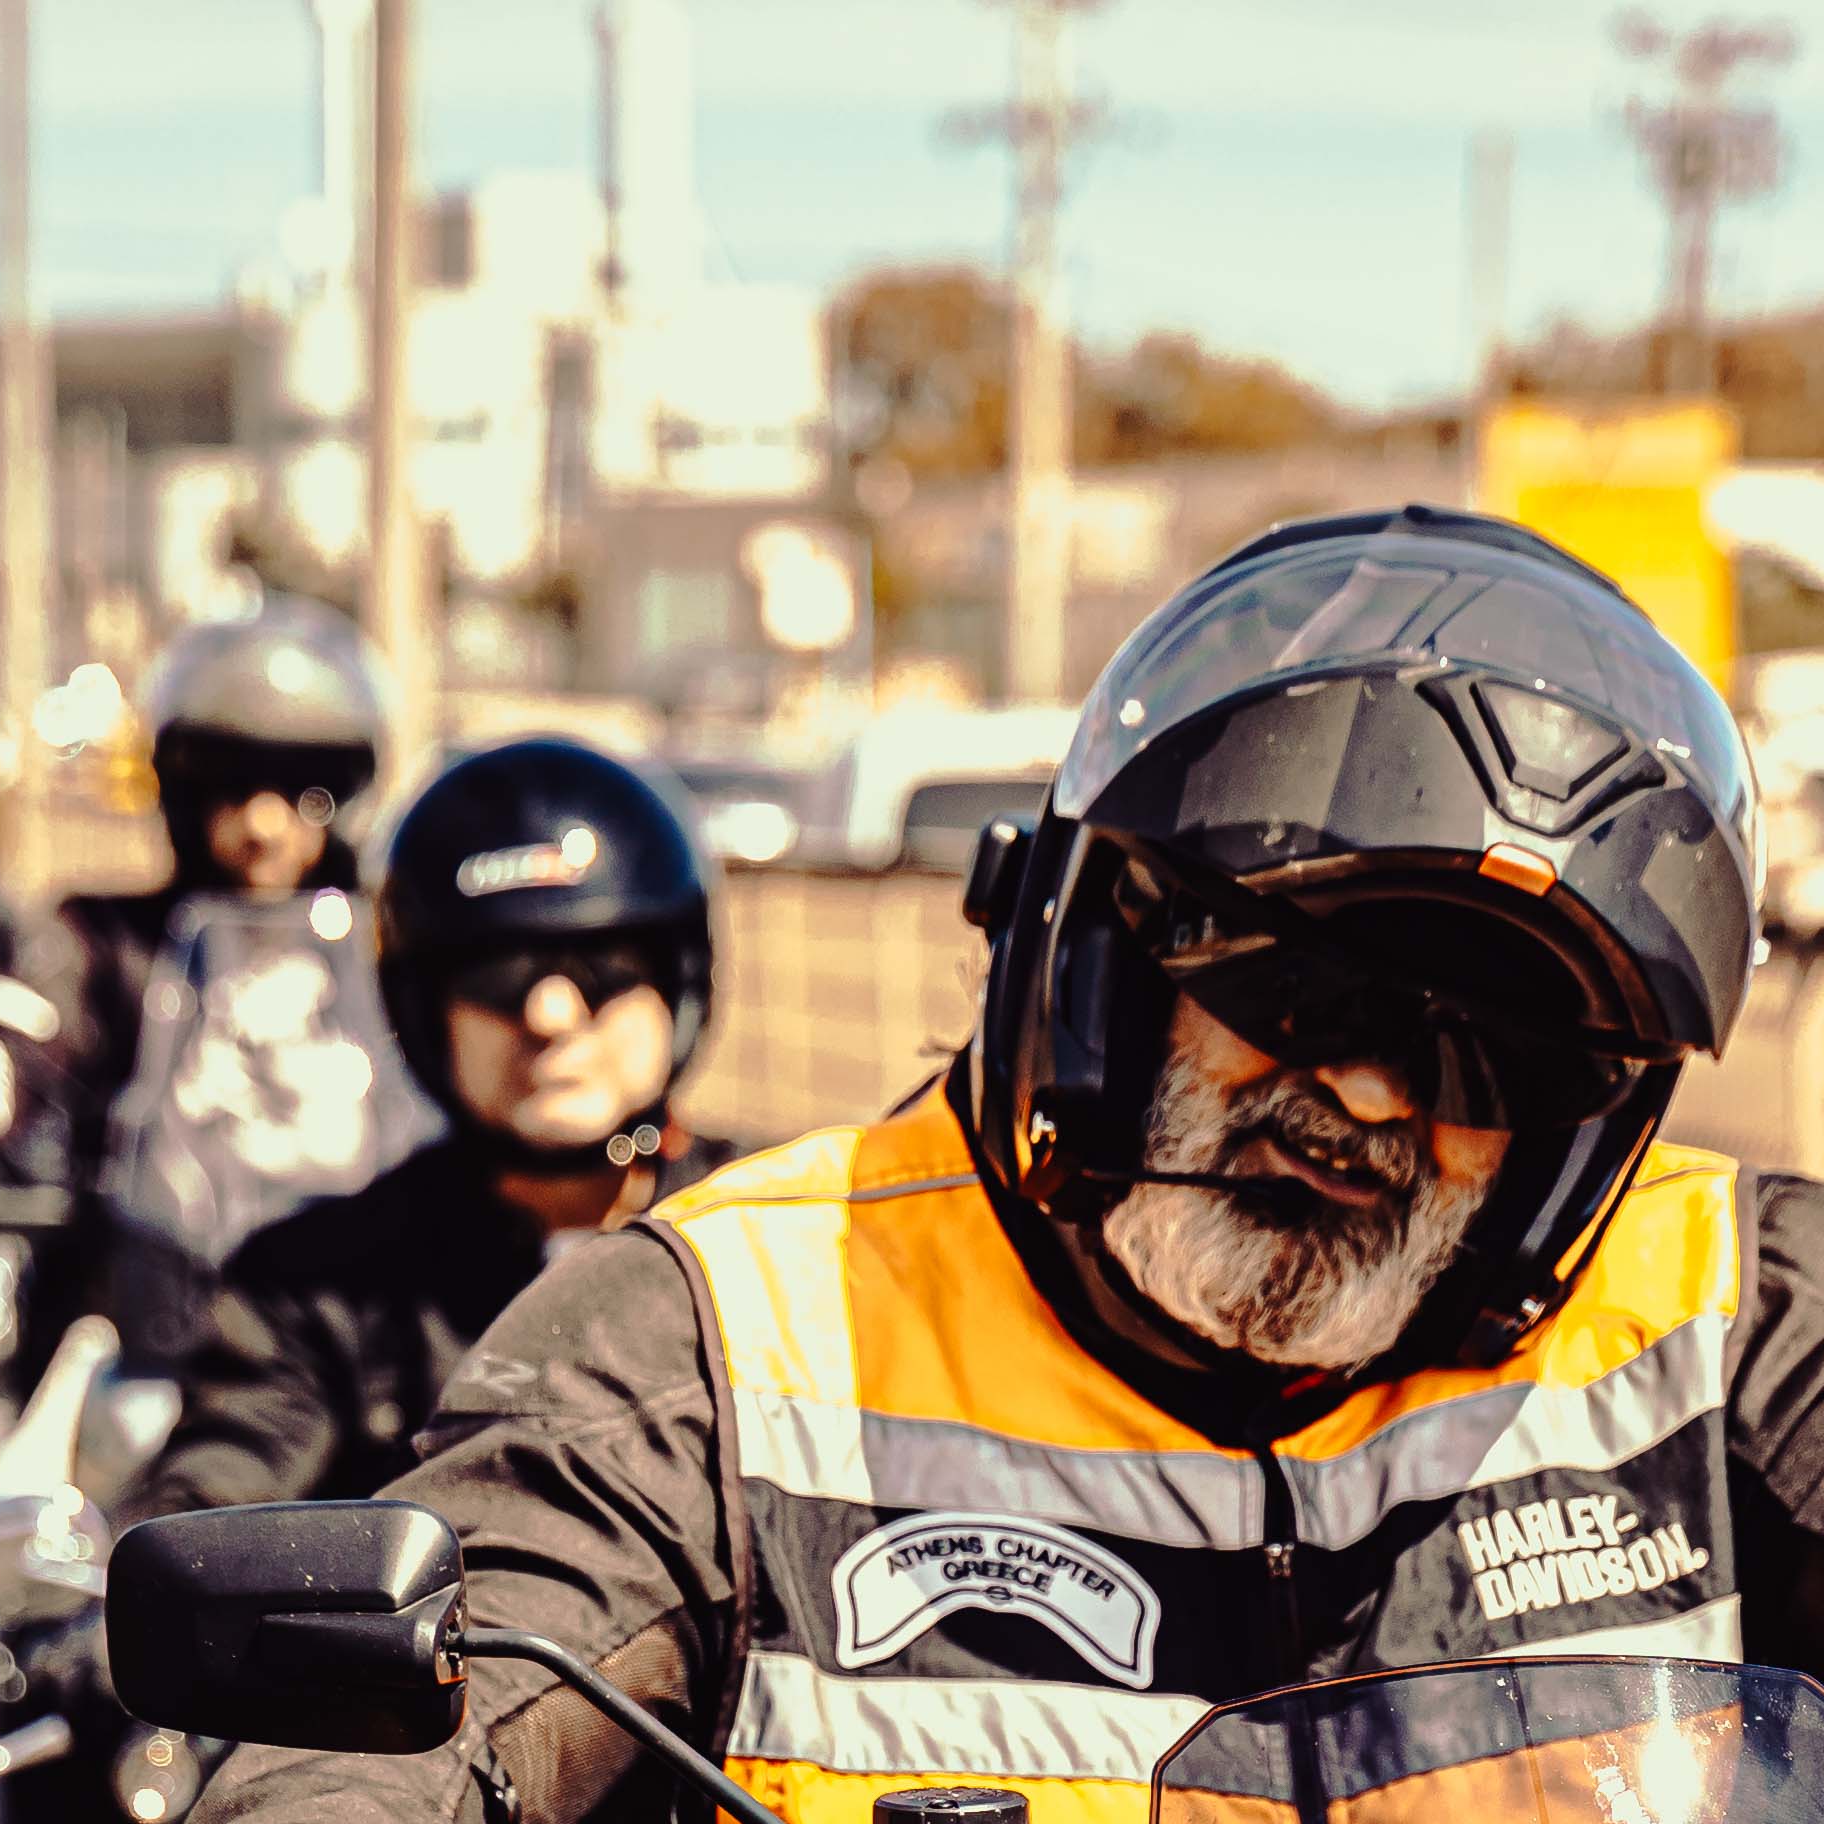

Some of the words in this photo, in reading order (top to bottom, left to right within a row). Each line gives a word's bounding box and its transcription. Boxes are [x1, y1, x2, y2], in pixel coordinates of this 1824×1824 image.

[887, 1537, 983, 1576] ATHENS
[998, 1538, 1115, 1598] CHAPTER
[1459, 1495, 1638, 1572] HARLEY-
[943, 1560, 1050, 1593] GREECE
[1475, 1524, 1697, 1620] DAVIDSON
